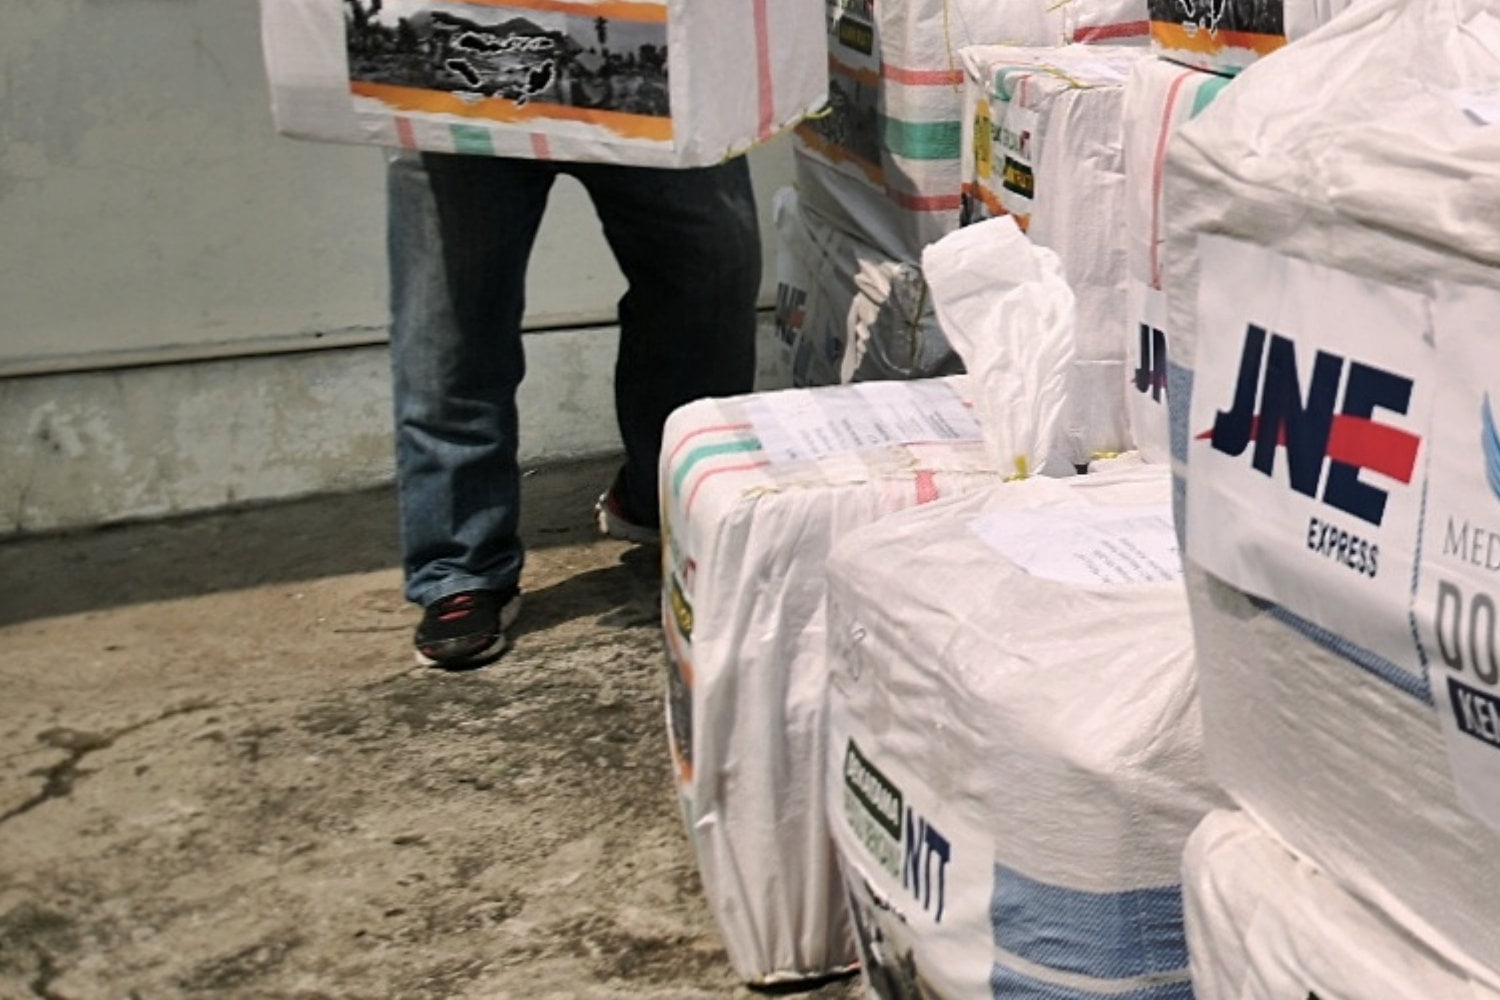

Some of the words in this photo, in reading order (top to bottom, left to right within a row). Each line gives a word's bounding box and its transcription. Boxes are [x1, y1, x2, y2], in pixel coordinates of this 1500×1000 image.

[1194, 323, 1422, 528] JNE
[1307, 516, 1380, 578] EXPRESS
[903, 806, 951, 923] NTT
